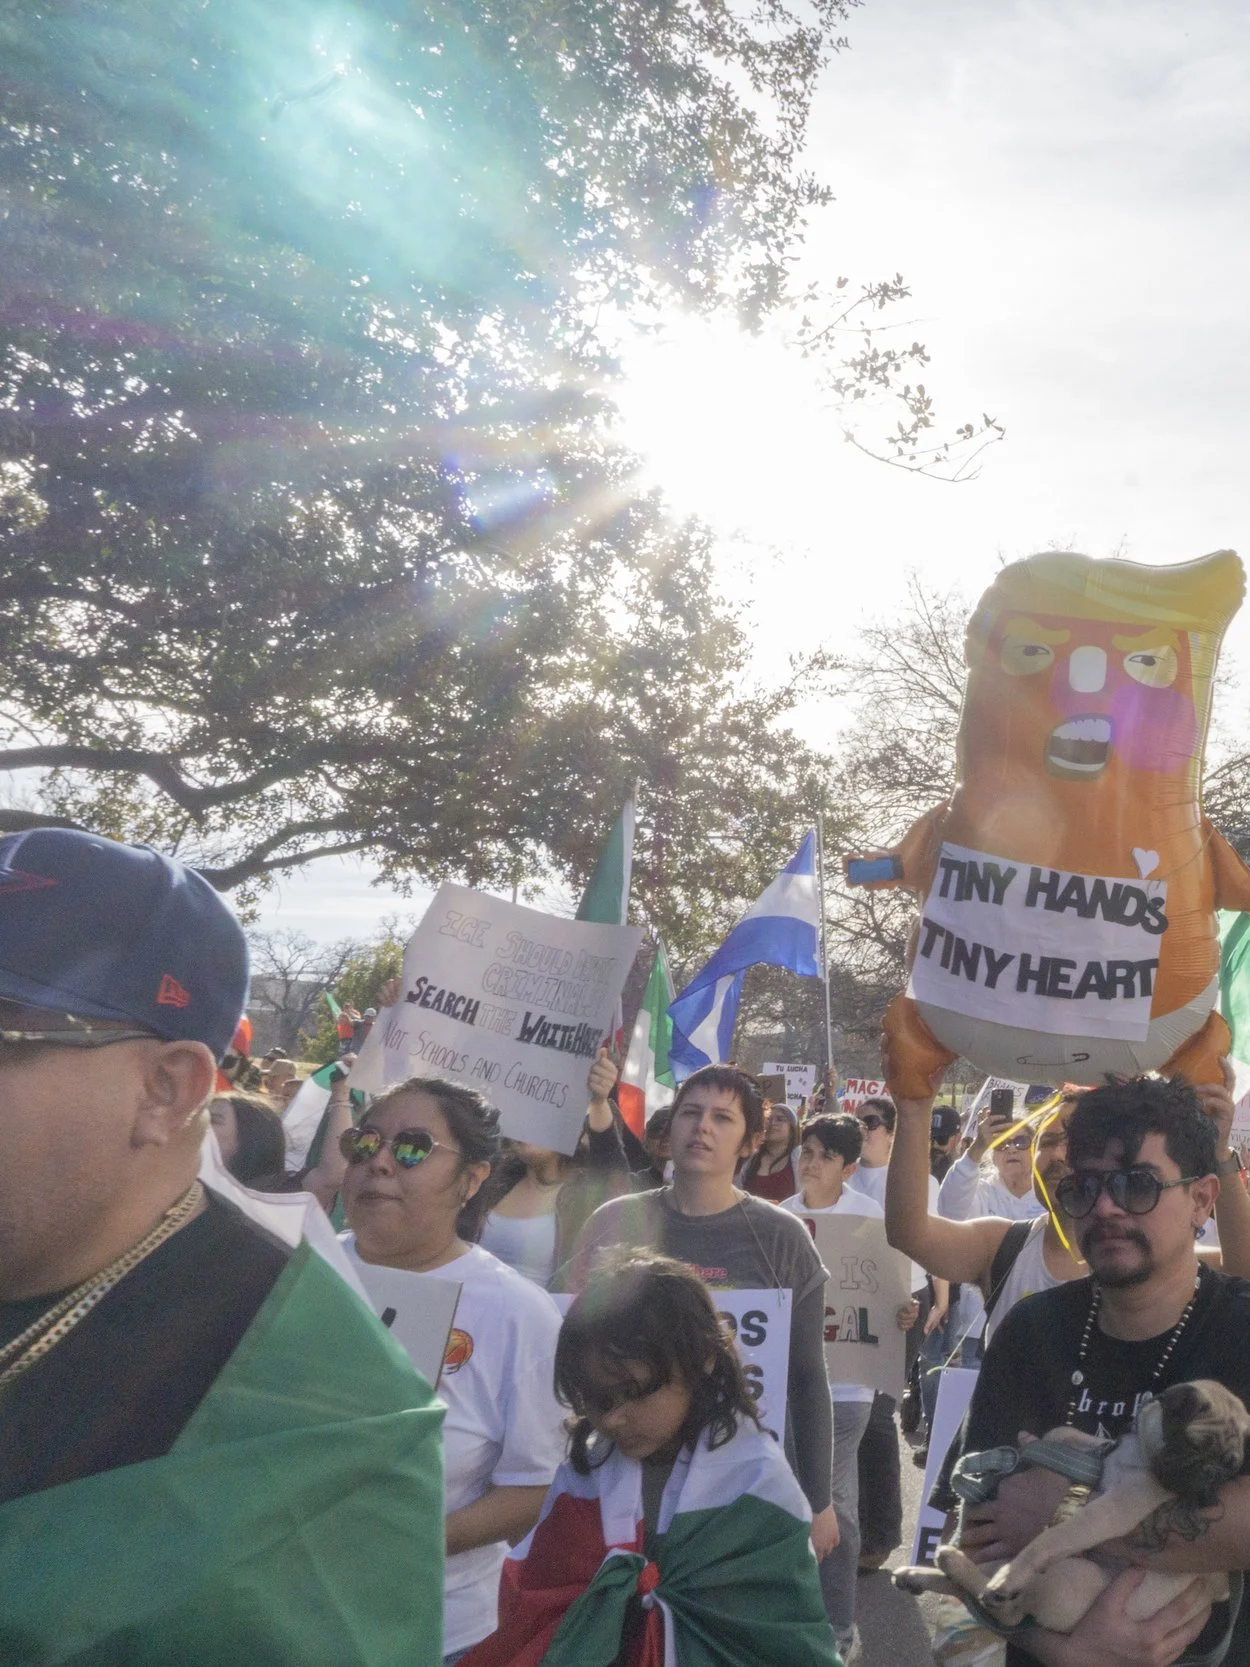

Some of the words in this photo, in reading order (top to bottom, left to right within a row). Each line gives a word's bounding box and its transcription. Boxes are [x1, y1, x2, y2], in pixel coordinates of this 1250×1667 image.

[939, 857, 1017, 906] TINY
[1025, 867, 1169, 935] HANDS
[438, 910, 492, 948] ICE
[496, 931, 573, 976] SHOULD
[920, 917, 1015, 989] TINY
[1016, 953, 1159, 1001] HEART
[404, 975, 480, 1026] SEARCH
[479, 1003, 518, 1036] THE
[381, 1021, 408, 1051] NOT
[409, 1030, 470, 1073] SCHOOLS
[470, 1057, 501, 1083] AND
[503, 1061, 569, 1108] CHURCHES
[840, 1256, 879, 1293] IS
